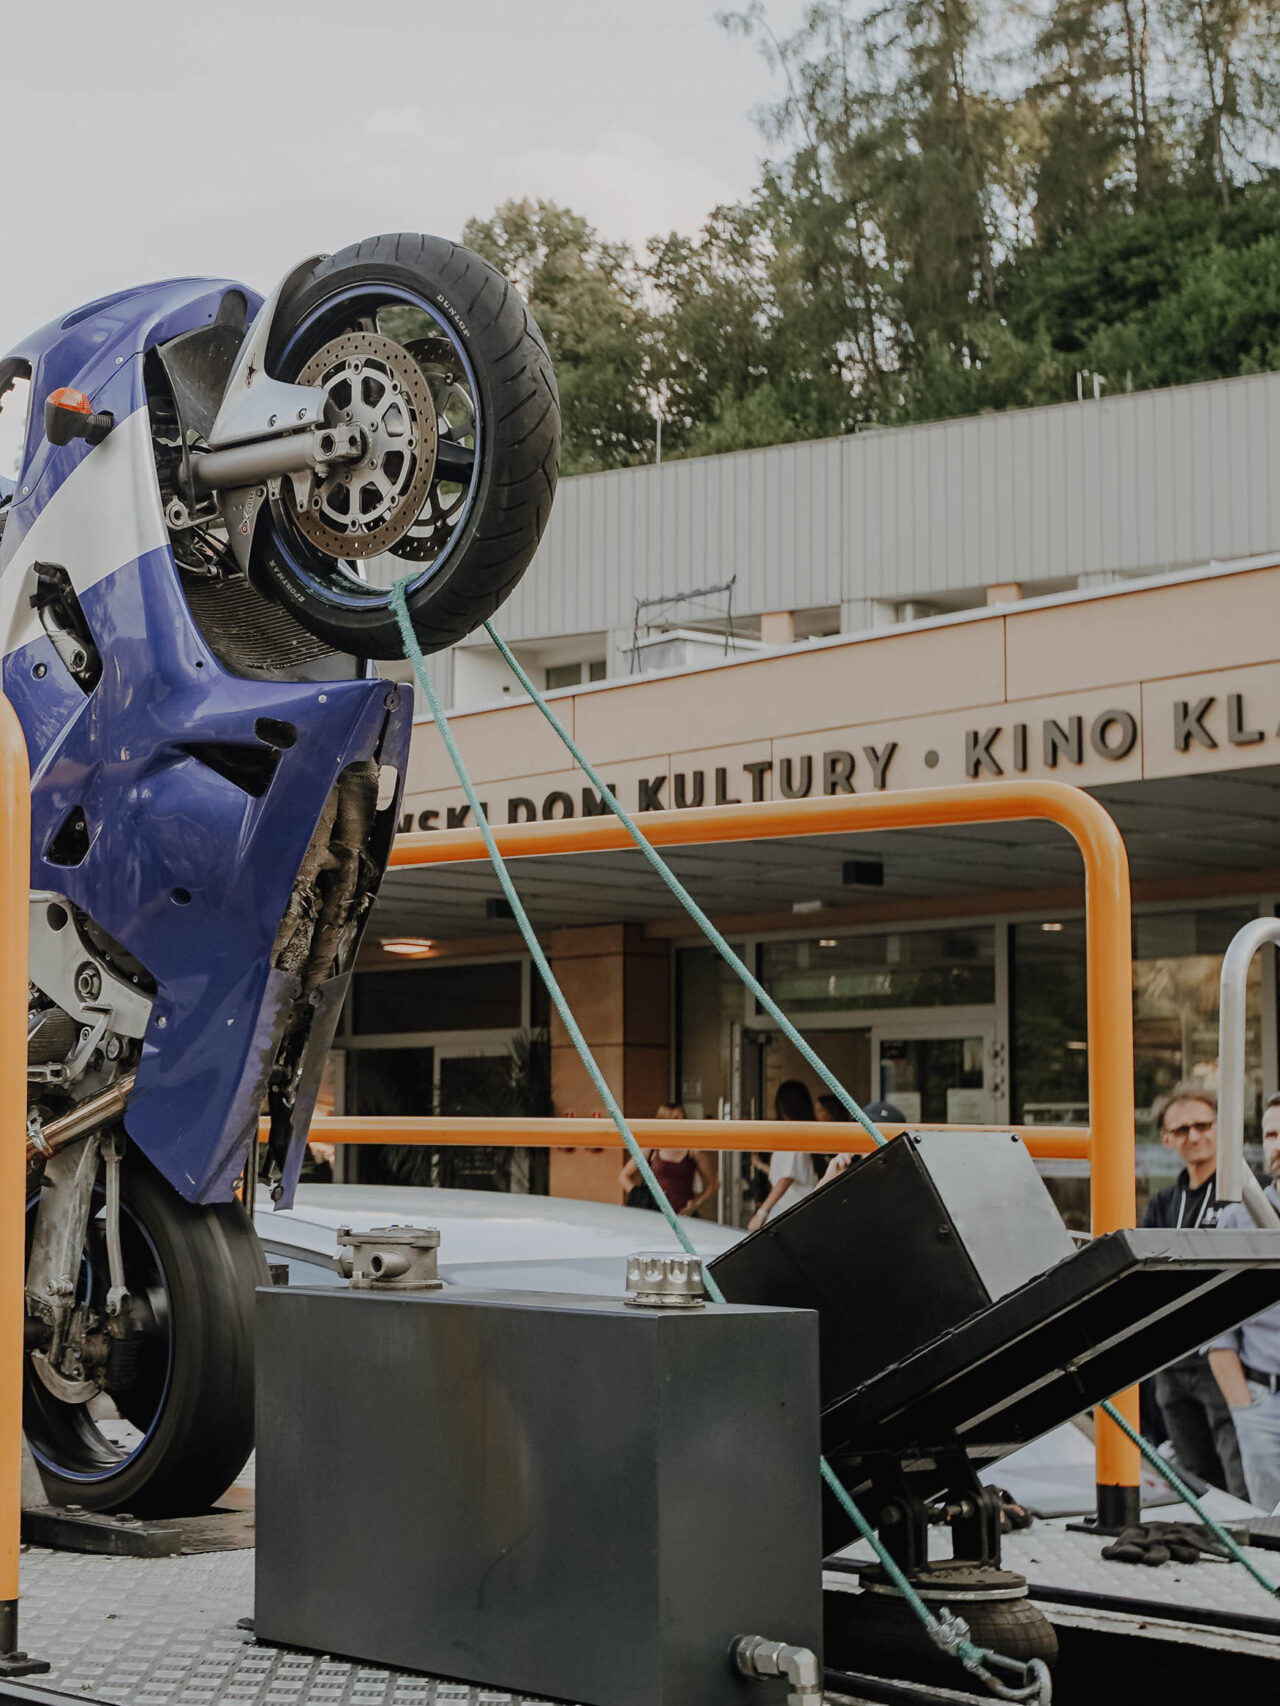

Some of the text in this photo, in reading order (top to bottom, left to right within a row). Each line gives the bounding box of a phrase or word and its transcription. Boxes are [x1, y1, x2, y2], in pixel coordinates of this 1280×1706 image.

[437, 294, 471, 337] DUNLOP
[269, 560, 305, 603] SPORTMAX
[508, 784, 617, 824] DOM
[638, 742, 898, 812] KULTURY
[965, 709, 1137, 778] KINO
[1174, 693, 1280, 753] KL
